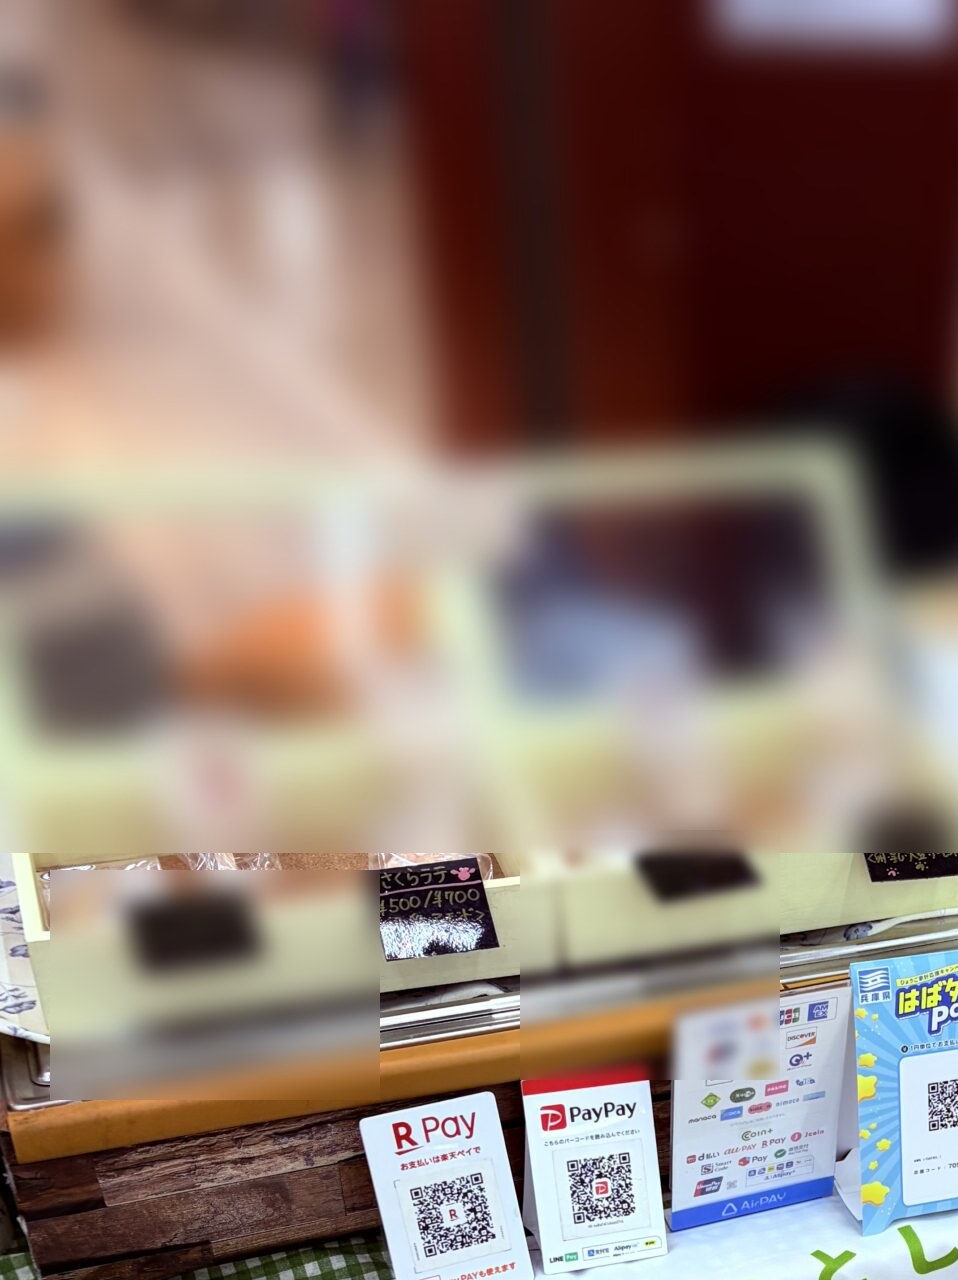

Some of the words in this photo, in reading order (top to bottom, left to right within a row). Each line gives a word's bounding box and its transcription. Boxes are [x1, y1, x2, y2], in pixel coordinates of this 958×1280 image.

[381, 866, 448, 889] さくらラテ
[860, 992, 891, 1003] 兵庫県
[570, 1102, 637, 1123] PayPay
[421, 1112, 476, 1143] Pay
[544, 1129, 640, 1147] こちらのバーコードを読み込んでください
[769, 1137, 787, 1145] Pay
[400, 1146, 481, 1171] お支払いは楽天ペイで
[752, 1155, 768, 1164] Pay
[549, 1255, 564, 1263] LINE
